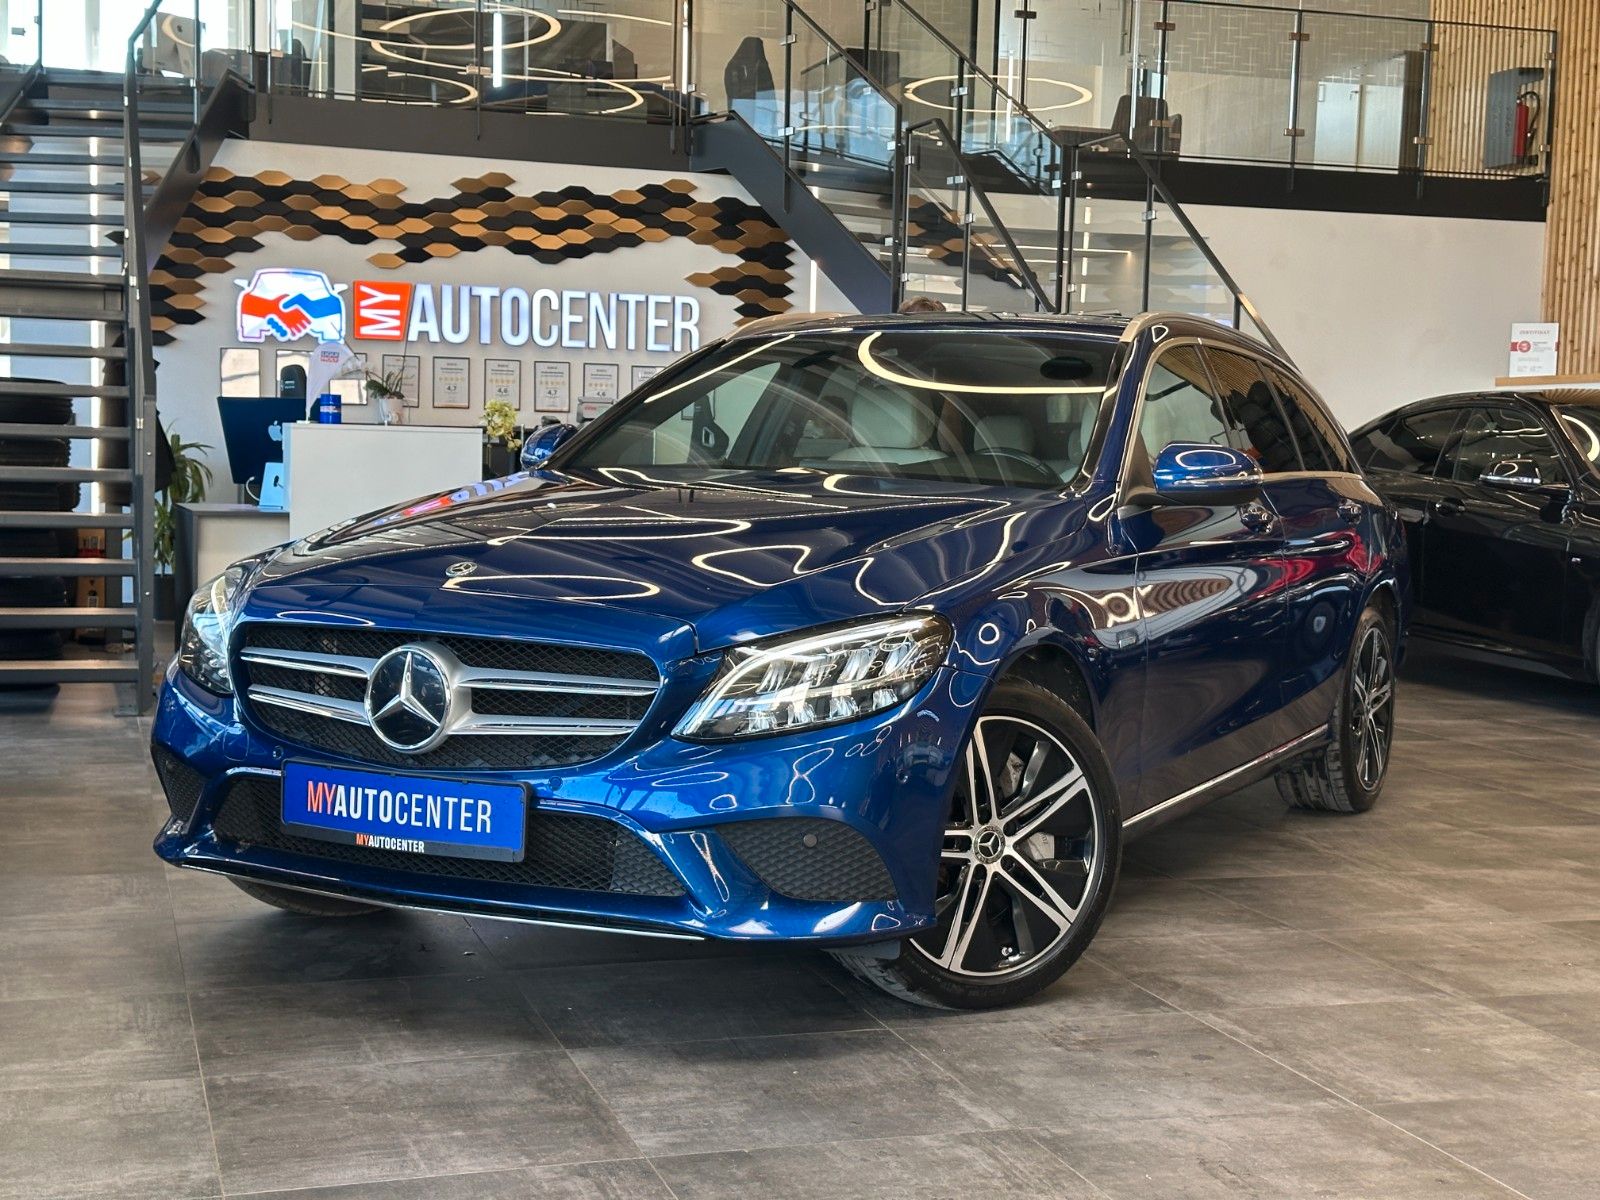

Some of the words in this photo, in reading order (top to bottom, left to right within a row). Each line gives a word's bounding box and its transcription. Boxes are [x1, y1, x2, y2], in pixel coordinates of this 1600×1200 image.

[359, 284, 401, 337] MY
[407, 283, 700, 352] AUTOCENTER
[307, 780, 492, 834] MYAUTOCENTER
[356, 834, 425, 853] MYAUTOCENTER
